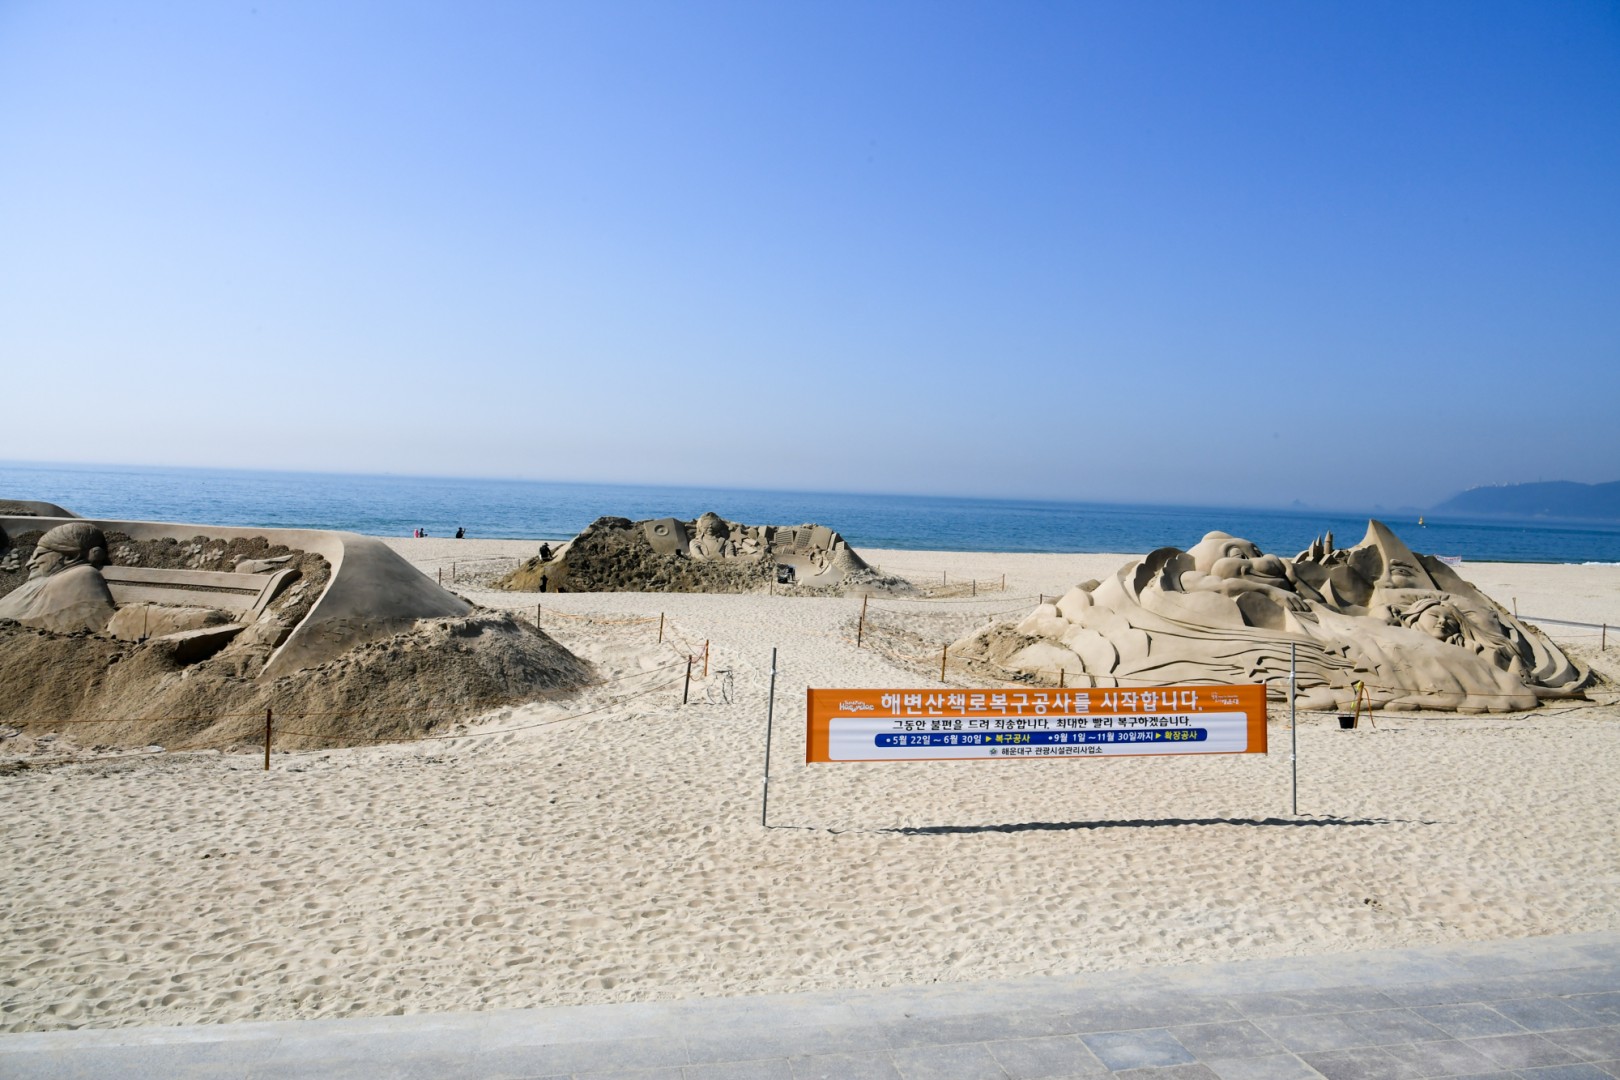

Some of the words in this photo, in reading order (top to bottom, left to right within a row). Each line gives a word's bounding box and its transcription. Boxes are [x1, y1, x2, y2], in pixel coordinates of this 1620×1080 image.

[881, 692, 1092, 715] 해변산책로복구공사를
[1100, 690, 1203, 712] 시작합니다.
[893, 720, 926, 731] 그동안
[931, 720, 963, 731] 불편을
[968, 719, 990, 730] 드려
[995, 718, 1050, 730] 죄송합니다.
[1056, 718, 1088, 729] 최대한
[1092, 717, 1113, 728] 빨리
[1118, 715, 1192, 728] 복구하겠습니다.
[910, 735, 931, 745] 22일
[943, 735, 959, 745] 6월
[961, 734, 982, 744] 30일
[995, 733, 1031, 744] 복구공사
[1072, 732, 1086, 743] 1일
[1117, 731, 1153, 741] 30일까지
[1164, 730, 1198, 740] 확장공사
[1001, 748, 1032, 756] 해운대구
[1035, 745, 1103, 755] 관광시설관리사업소
